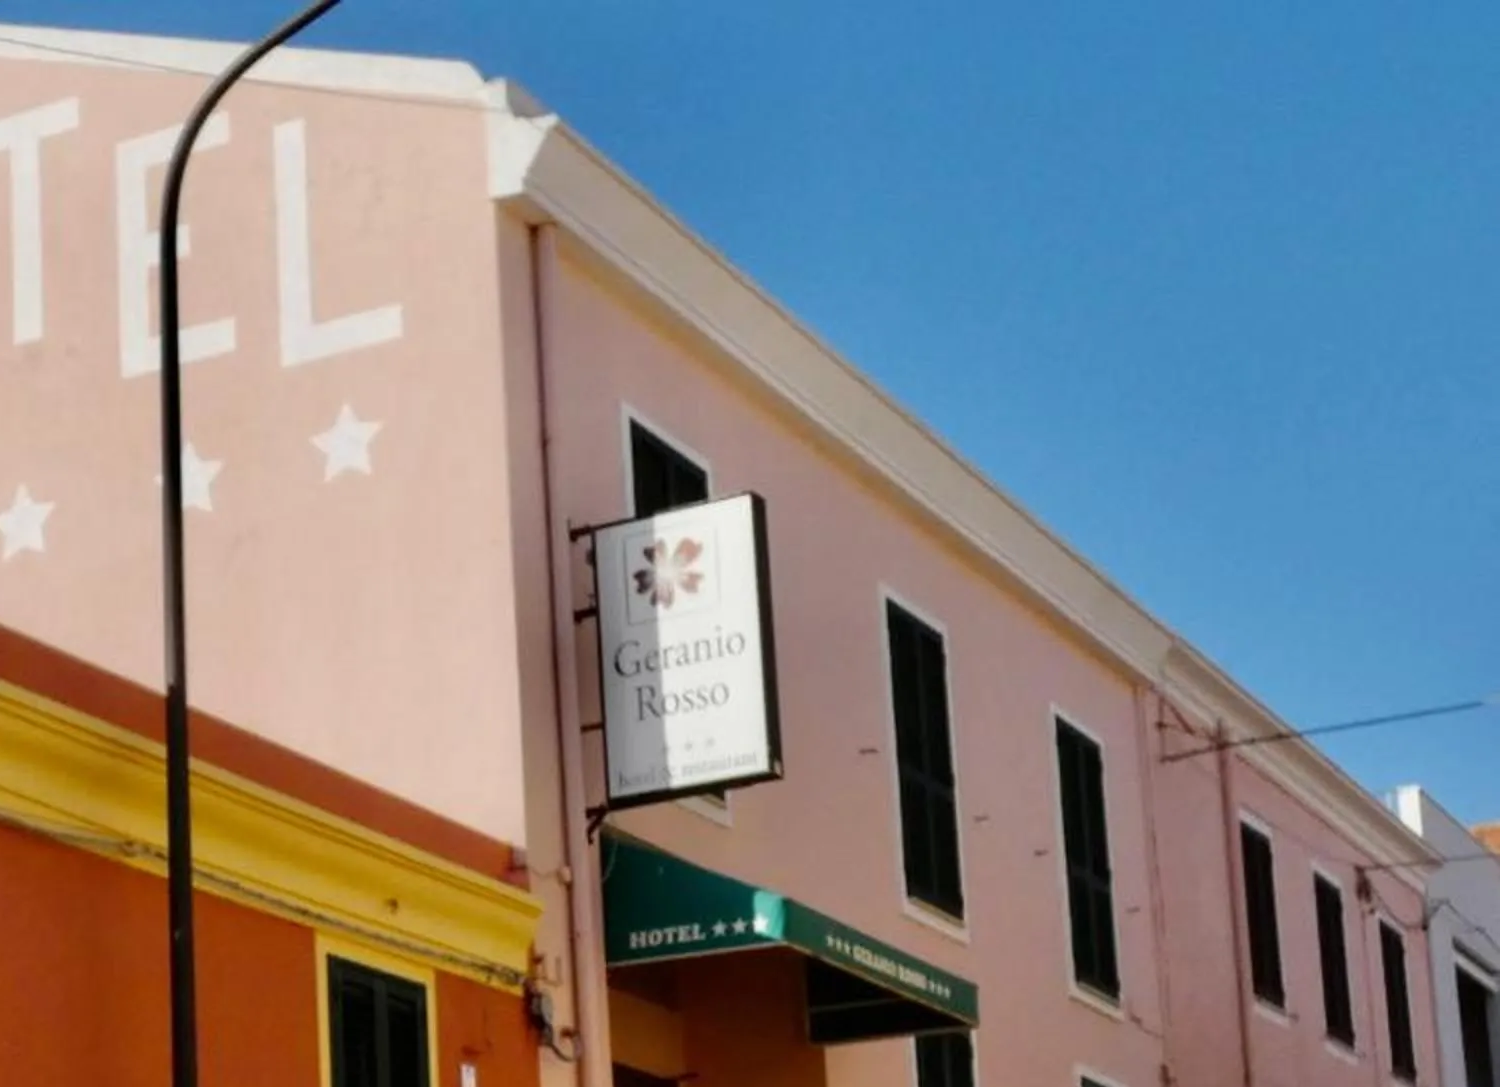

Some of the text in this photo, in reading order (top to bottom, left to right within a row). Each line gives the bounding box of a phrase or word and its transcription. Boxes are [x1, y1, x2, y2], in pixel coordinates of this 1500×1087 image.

[614, 624, 746, 679] Geranio
[634, 682, 730, 722] Rosso
[629, 923, 707, 949] HOTEL
